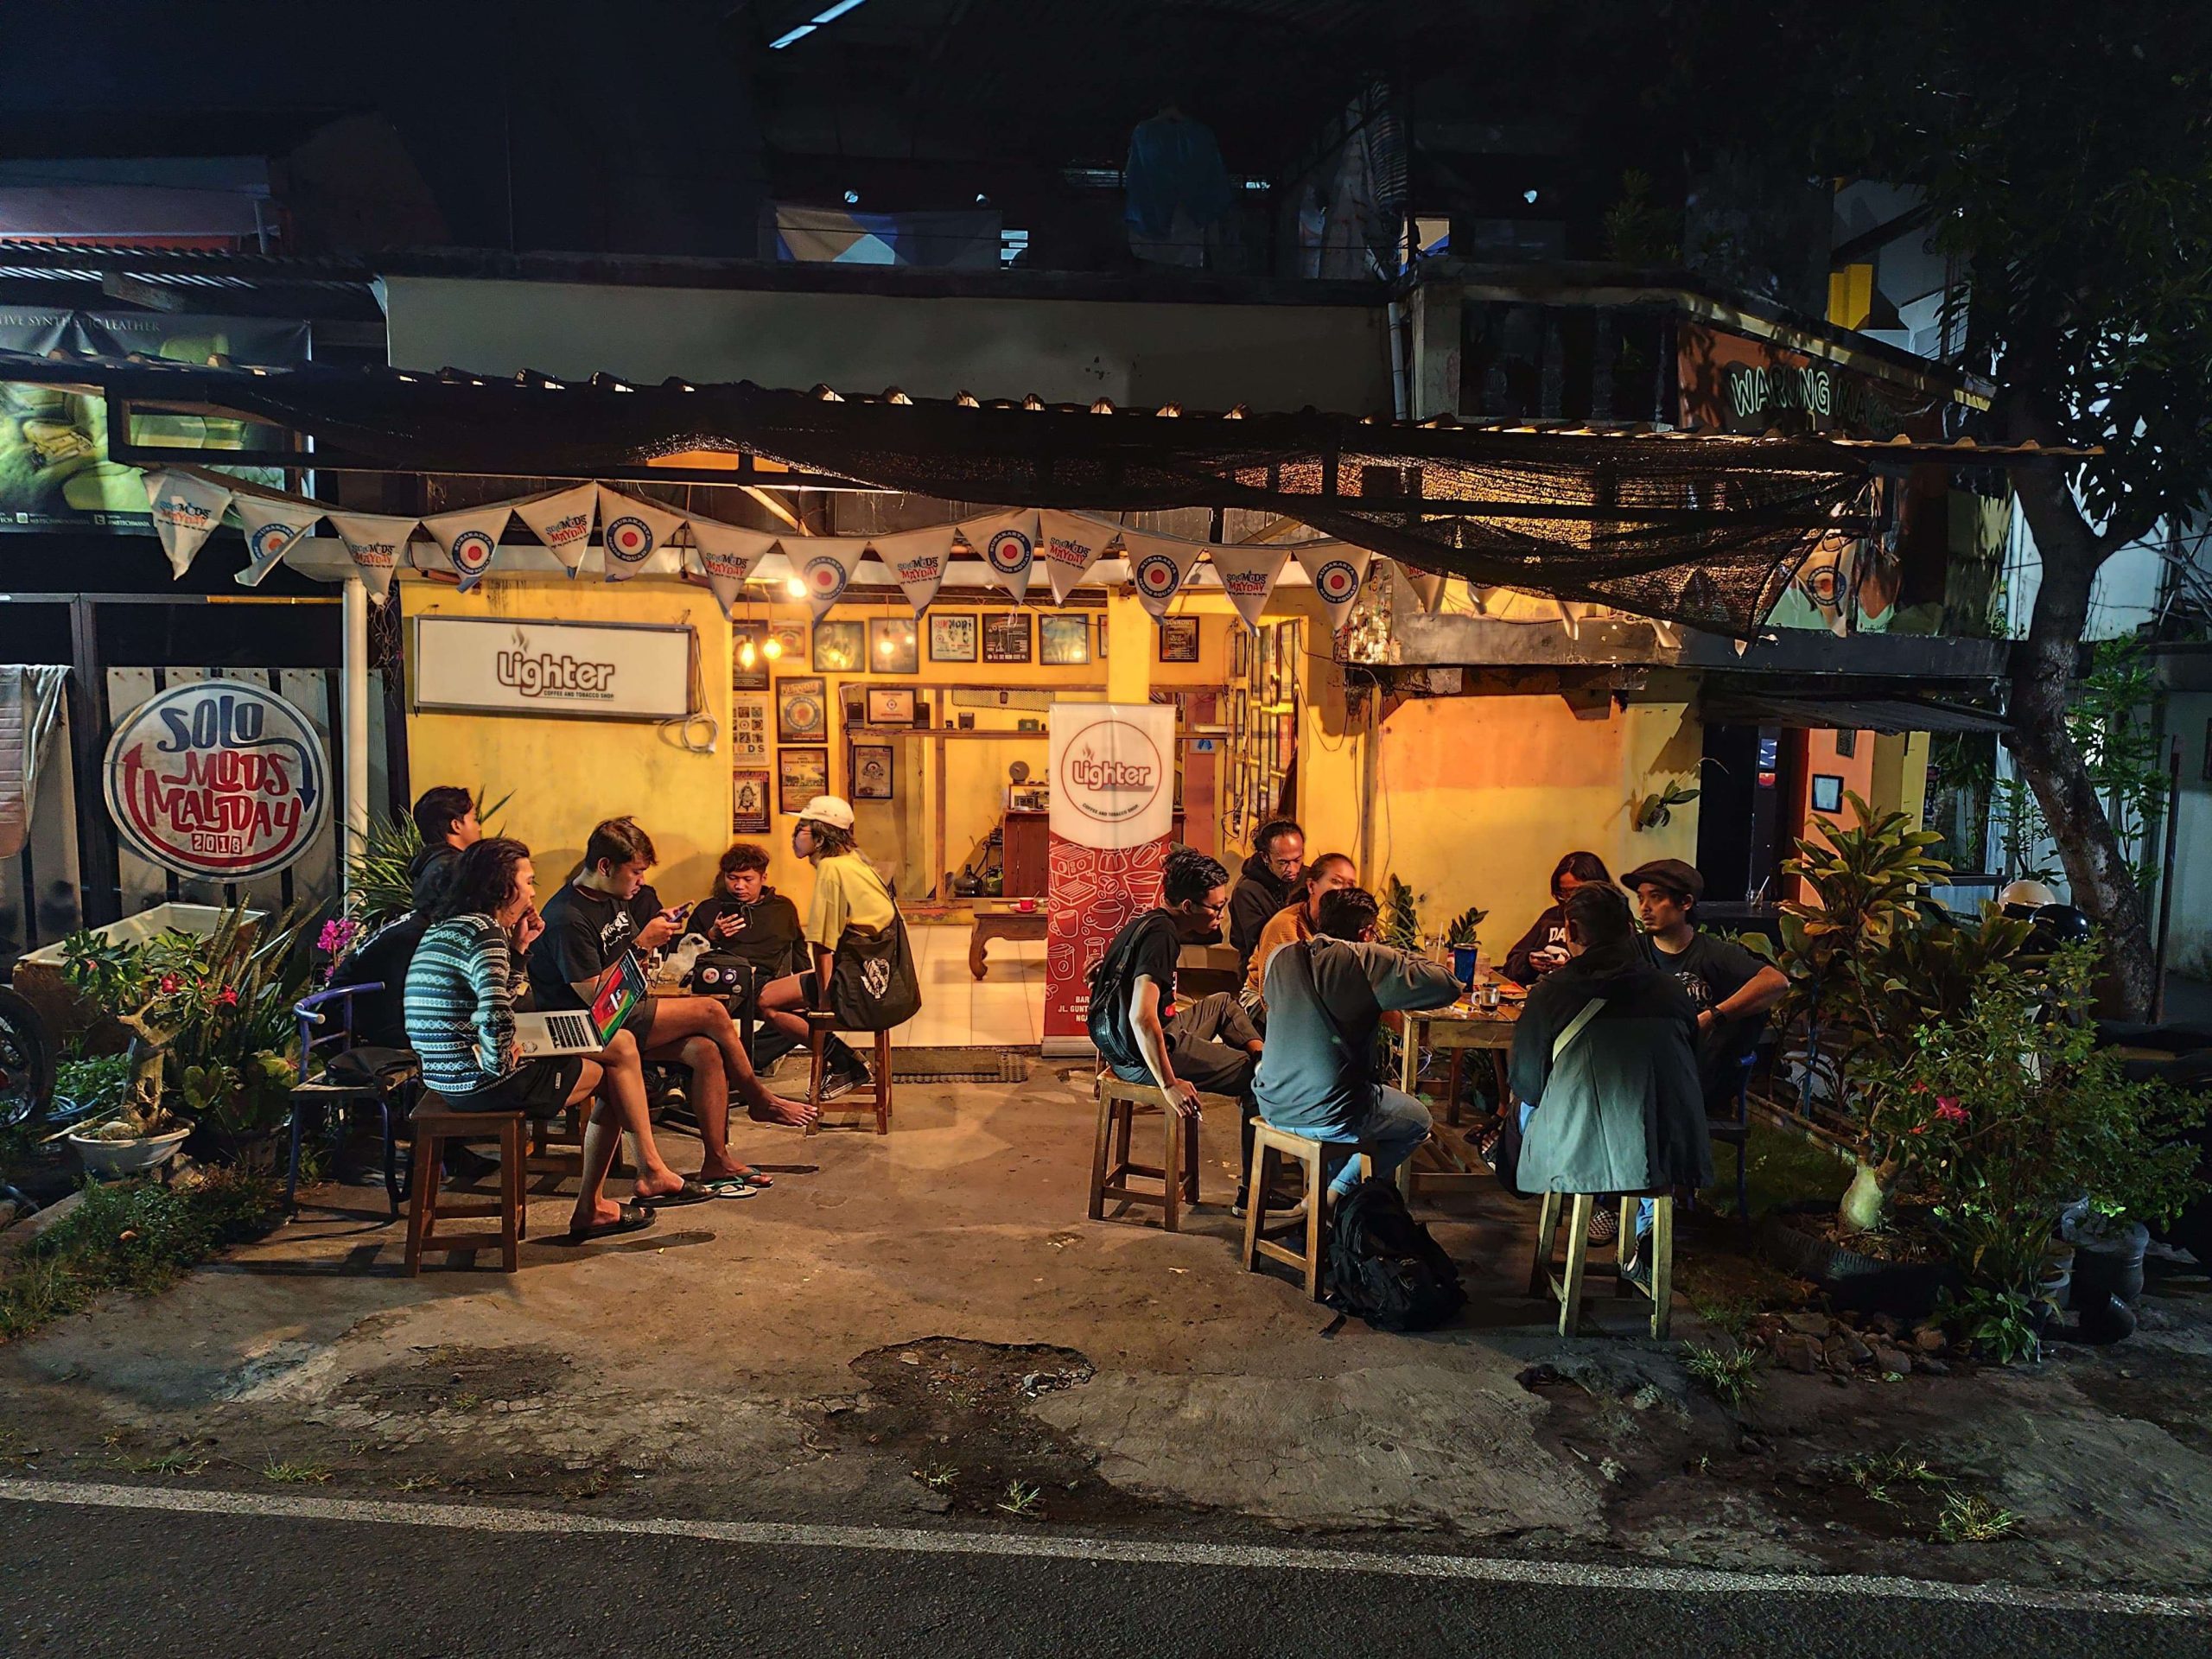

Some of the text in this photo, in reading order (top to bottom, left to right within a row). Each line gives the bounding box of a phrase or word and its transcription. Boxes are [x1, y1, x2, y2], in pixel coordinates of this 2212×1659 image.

[1731, 365, 1830, 418] WARUNG
[551, 524, 588, 543] MAYDAY
[989, 531, 1026, 552] SURAKARTA
[1049, 544, 1086, 564] MAYDAY
[706, 559, 745, 576] MAYDAY
[901, 567, 938, 580] MAYDAY
[1141, 556, 1176, 575] SURAKARTA
[1318, 562, 1354, 580] SURAKARTA
[1228, 581, 1265, 593] MAYDAY
[497, 651, 615, 697] Lighter
[157, 695, 264, 753] SOLO
[161, 749, 291, 797] MODS
[1071, 760, 1152, 791] Lighter
[192, 833, 243, 855] 2018
[1549, 927, 1567, 943] DA
